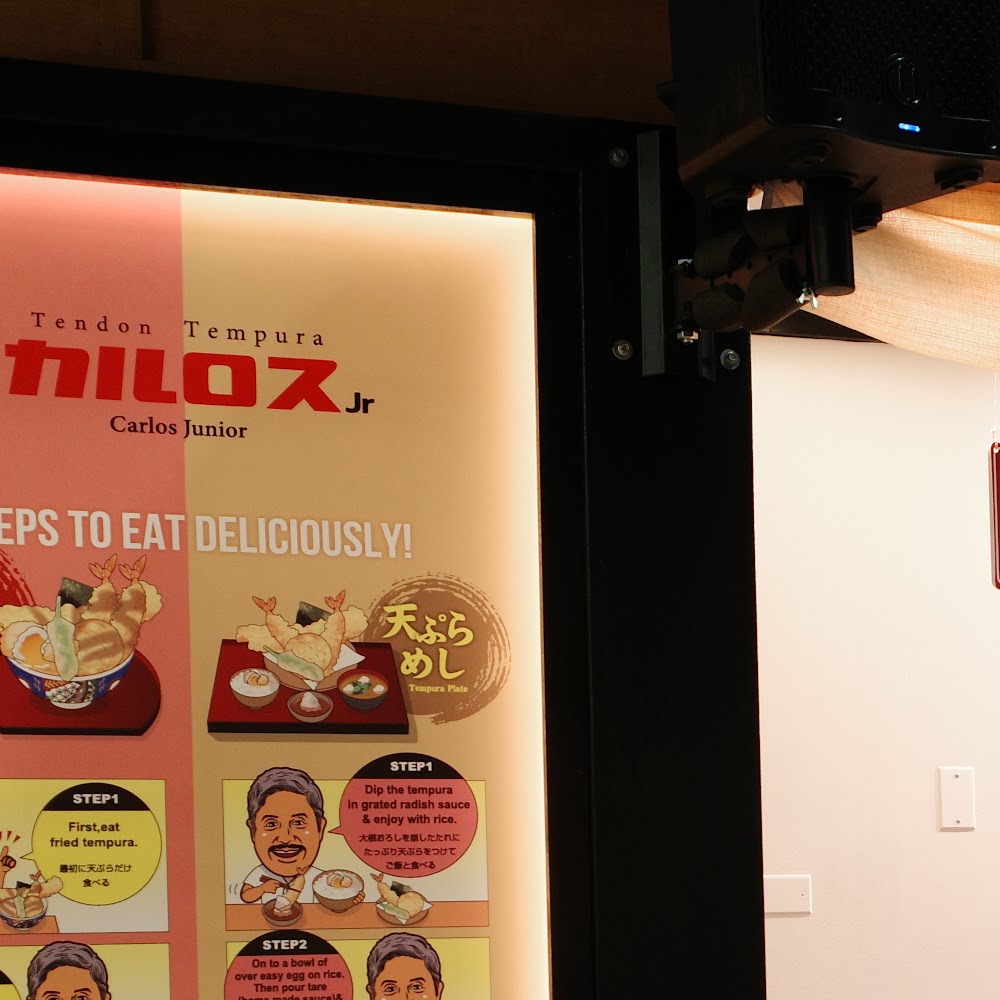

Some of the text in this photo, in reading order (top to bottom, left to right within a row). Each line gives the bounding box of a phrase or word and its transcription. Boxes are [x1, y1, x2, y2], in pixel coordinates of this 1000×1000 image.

[31, 311, 324, 347] Tendon Tempura
[4, 338, 375, 414] カルロス Jr
[110, 415, 248, 439] Carlos Junior
[67, 510, 112, 549] TO
[121, 512, 186, 551] EAT
[195, 515, 412, 559] DELICIOUSLY!
[382, 603, 474, 647] 天ぷら
[400, 646, 466, 680] めし
[408, 684, 469, 694] Tempura Plate
[390, 761, 433, 772] STEP1
[365, 784, 453, 797] Dip the tempura
[72, 793, 119, 805] STEP1
[347, 799, 471, 812] in grated radish sauce
[362, 814, 458, 826] & enjoy with rice.
[50, 837, 139, 850] fried tempura.
[82, 878, 110, 888] 食べる
[262, 939, 308, 951] STEP2
[252, 957, 328, 968] On to a bowl of
[234, 969, 345, 982] over easy egg on rice.
[253, 982, 327, 994] Then pour tare
